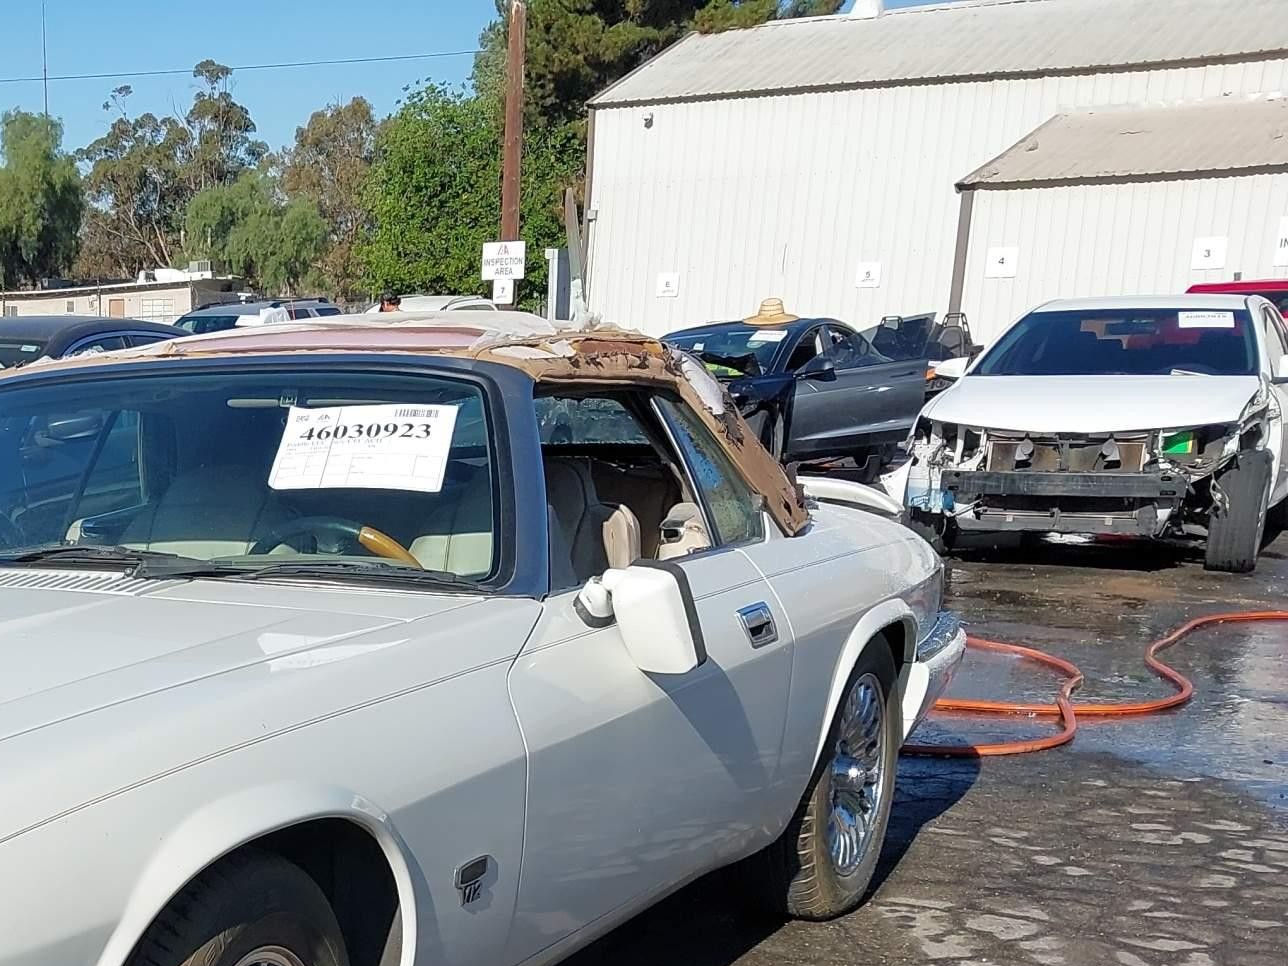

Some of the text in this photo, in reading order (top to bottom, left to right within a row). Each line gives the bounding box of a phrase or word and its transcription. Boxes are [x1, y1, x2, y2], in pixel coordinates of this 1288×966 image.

[1203, 249, 1211, 258] 3
[483, 256, 524, 268] INSPECTION
[997, 257, 1005, 265] 4
[494, 266, 514, 276] AREA
[299, 422, 432, 441] 46030923
